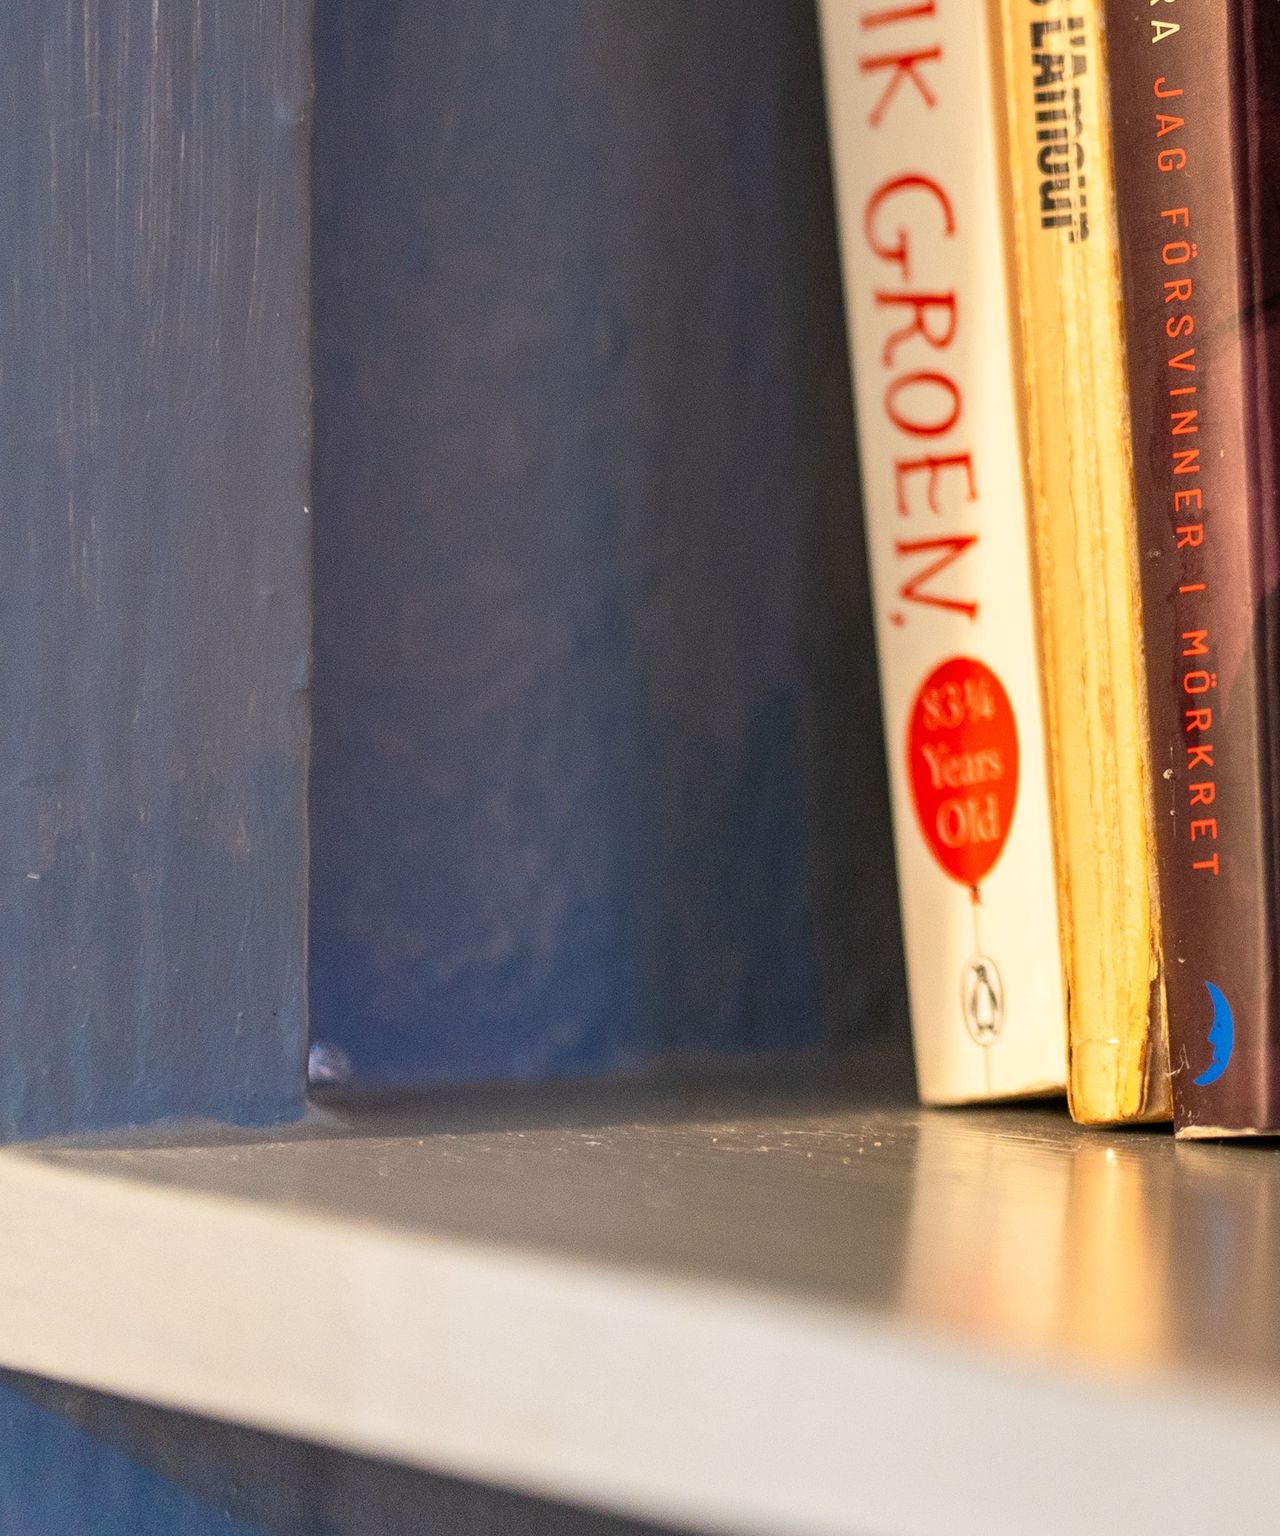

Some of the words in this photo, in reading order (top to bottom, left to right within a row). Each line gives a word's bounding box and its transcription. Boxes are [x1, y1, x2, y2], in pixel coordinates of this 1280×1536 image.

[1029, 15, 1090, 245] L'Amour
[1153, 75, 1188, 173] JAG
[863, 170, 981, 630] GROEN,
[1160, 206, 1206, 549] FÖRSVINNER
[1178, 582, 1207, 594] I
[920, 739, 1004, 791] Years
[935, 791, 1000, 850] Old
[1180, 628, 1220, 877] MÖRKRET
